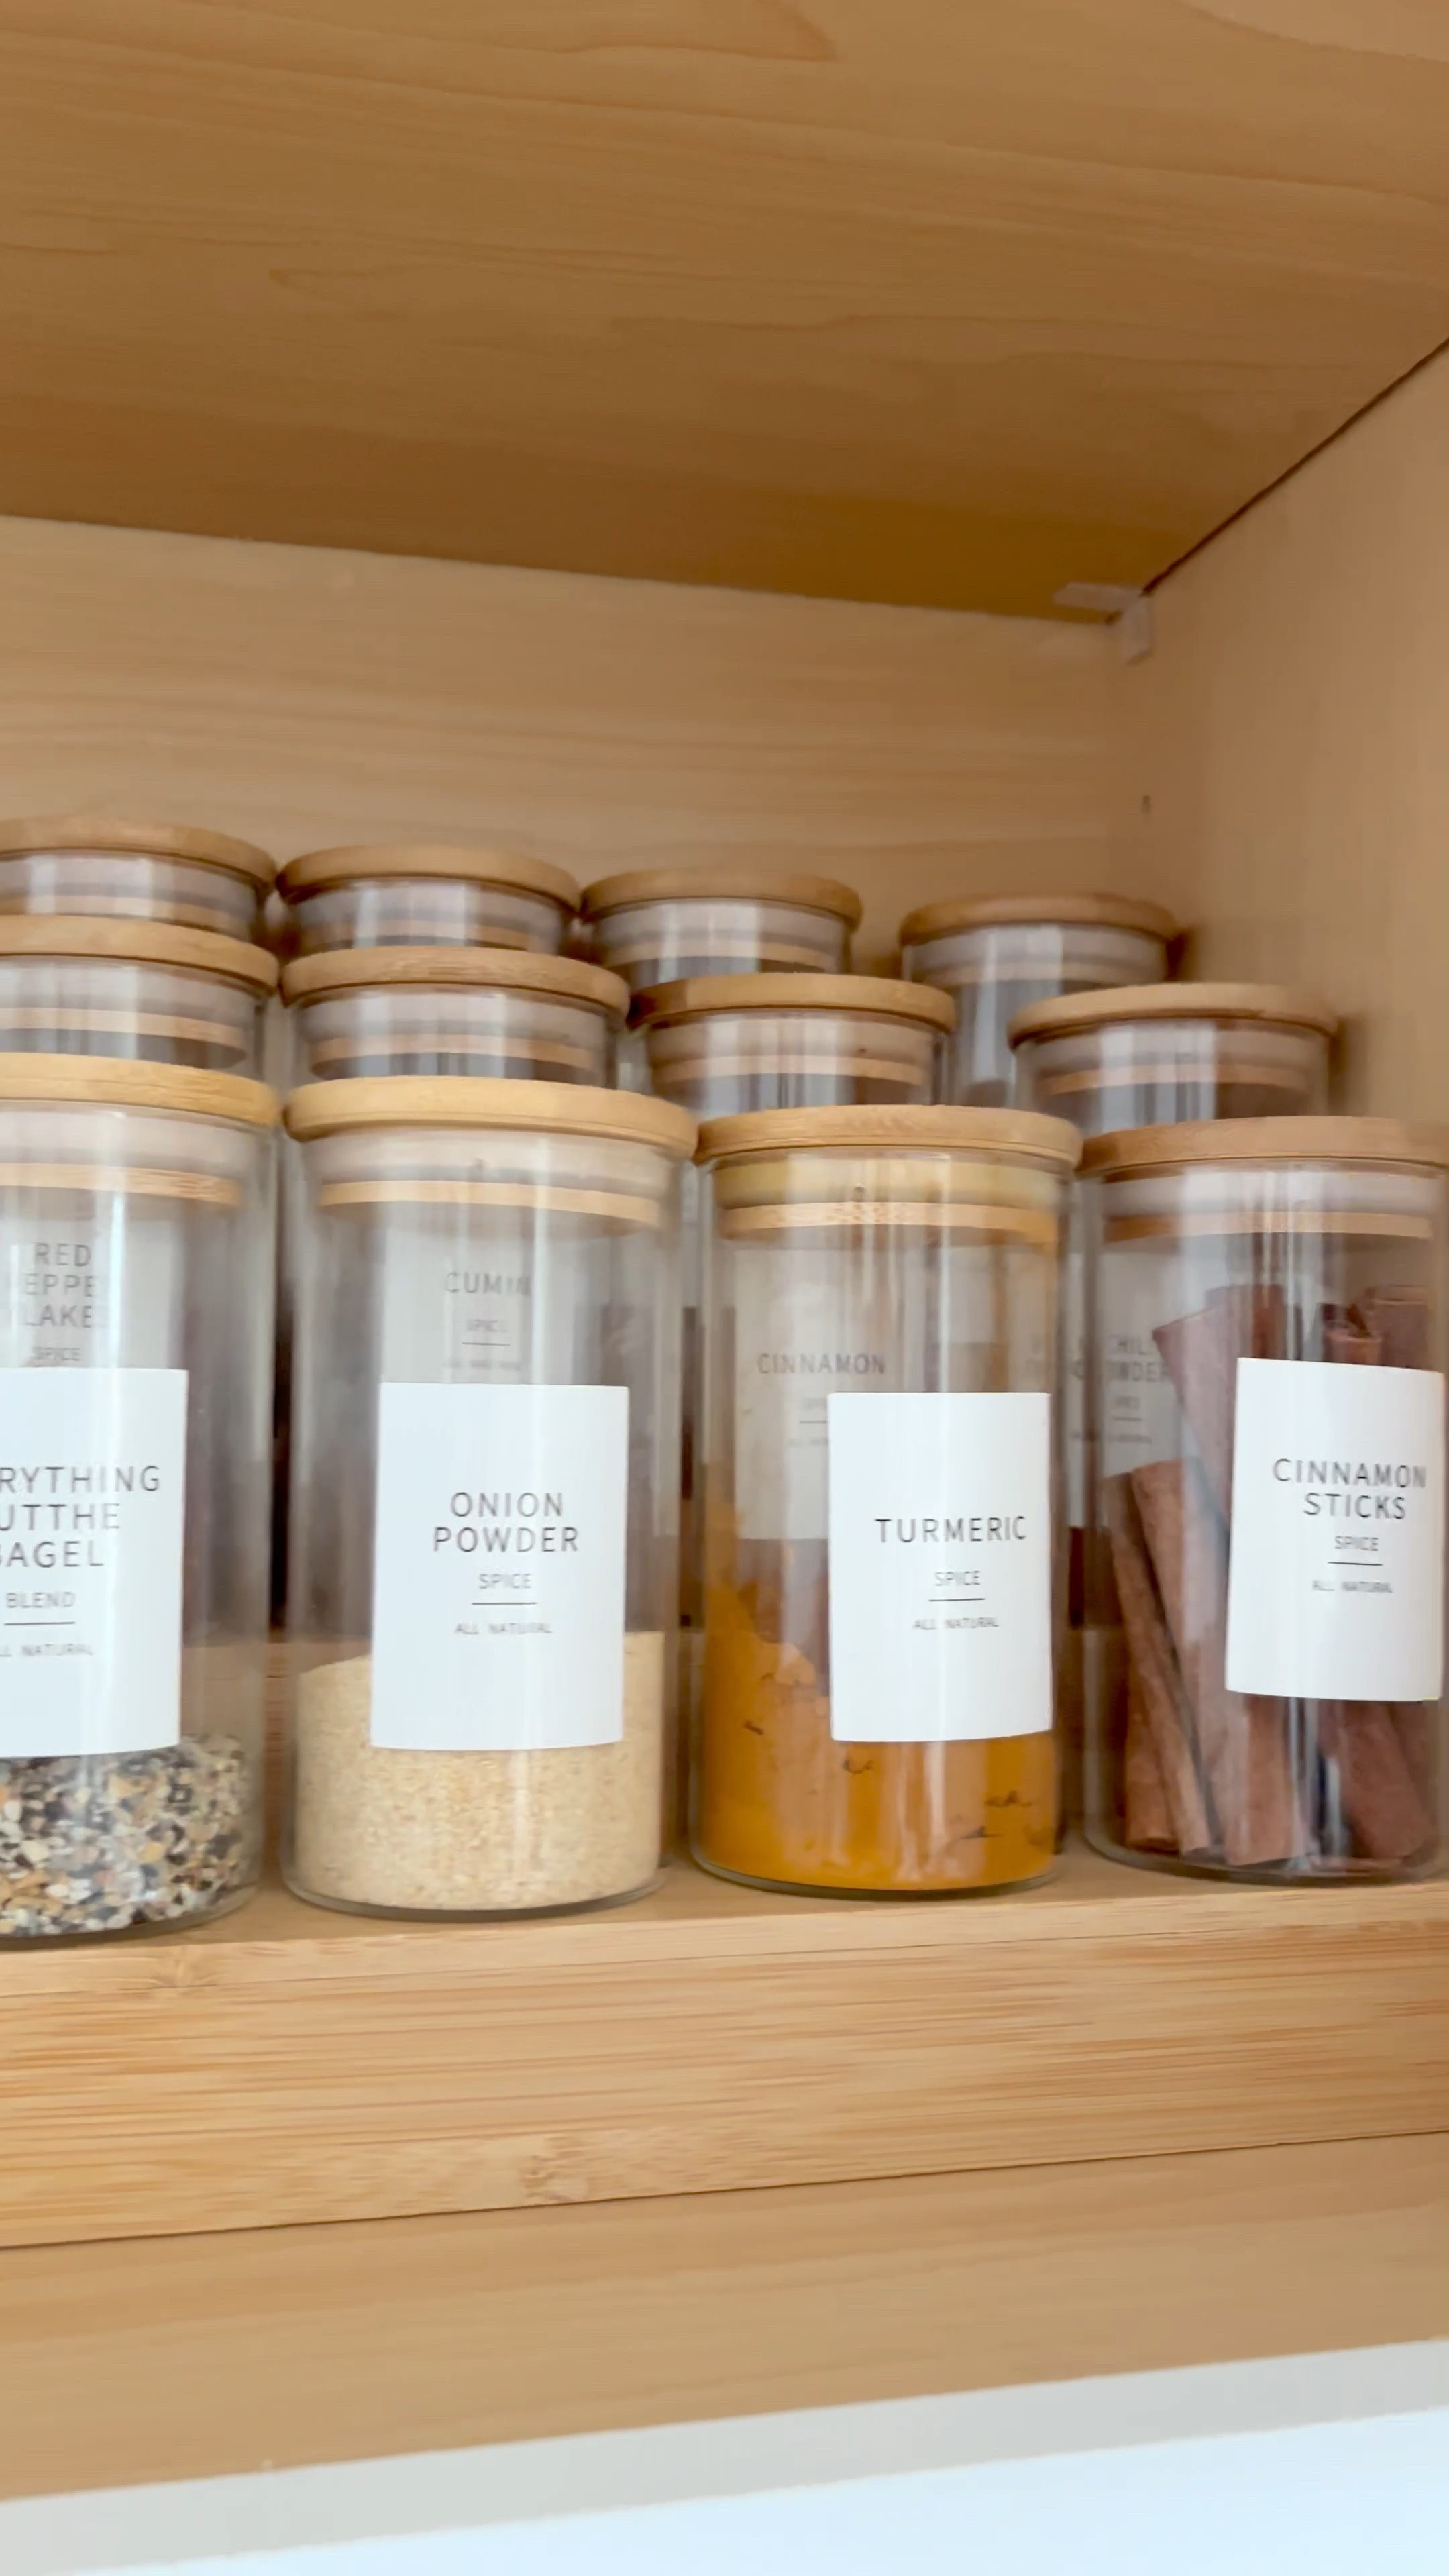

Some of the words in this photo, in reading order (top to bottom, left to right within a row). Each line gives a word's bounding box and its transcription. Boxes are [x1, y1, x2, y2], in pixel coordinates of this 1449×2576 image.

[35, 1242, 92, 1267] RED
[24, 1273, 95, 1298] EPPE
[24, 1304, 94, 1328] LAKE
[757, 1352, 885, 1375] CINNAMON
[1273, 1458, 1426, 1487] CINNAMON
[450, 1491, 562, 1517] ONION
[1303, 1492, 1405, 1519] STICKS
[433, 1526, 578, 1553] POWDER
[874, 1515, 1027, 1543] TURMERIC
[0, 1541, 104, 1568] AGEL
[1334, 1536, 1379, 1552] SPICE
[479, 1573, 532, 1589] SPICE
[935, 1570, 980, 1586] SPICE
[6, 1591, 76, 1609] BLEND
